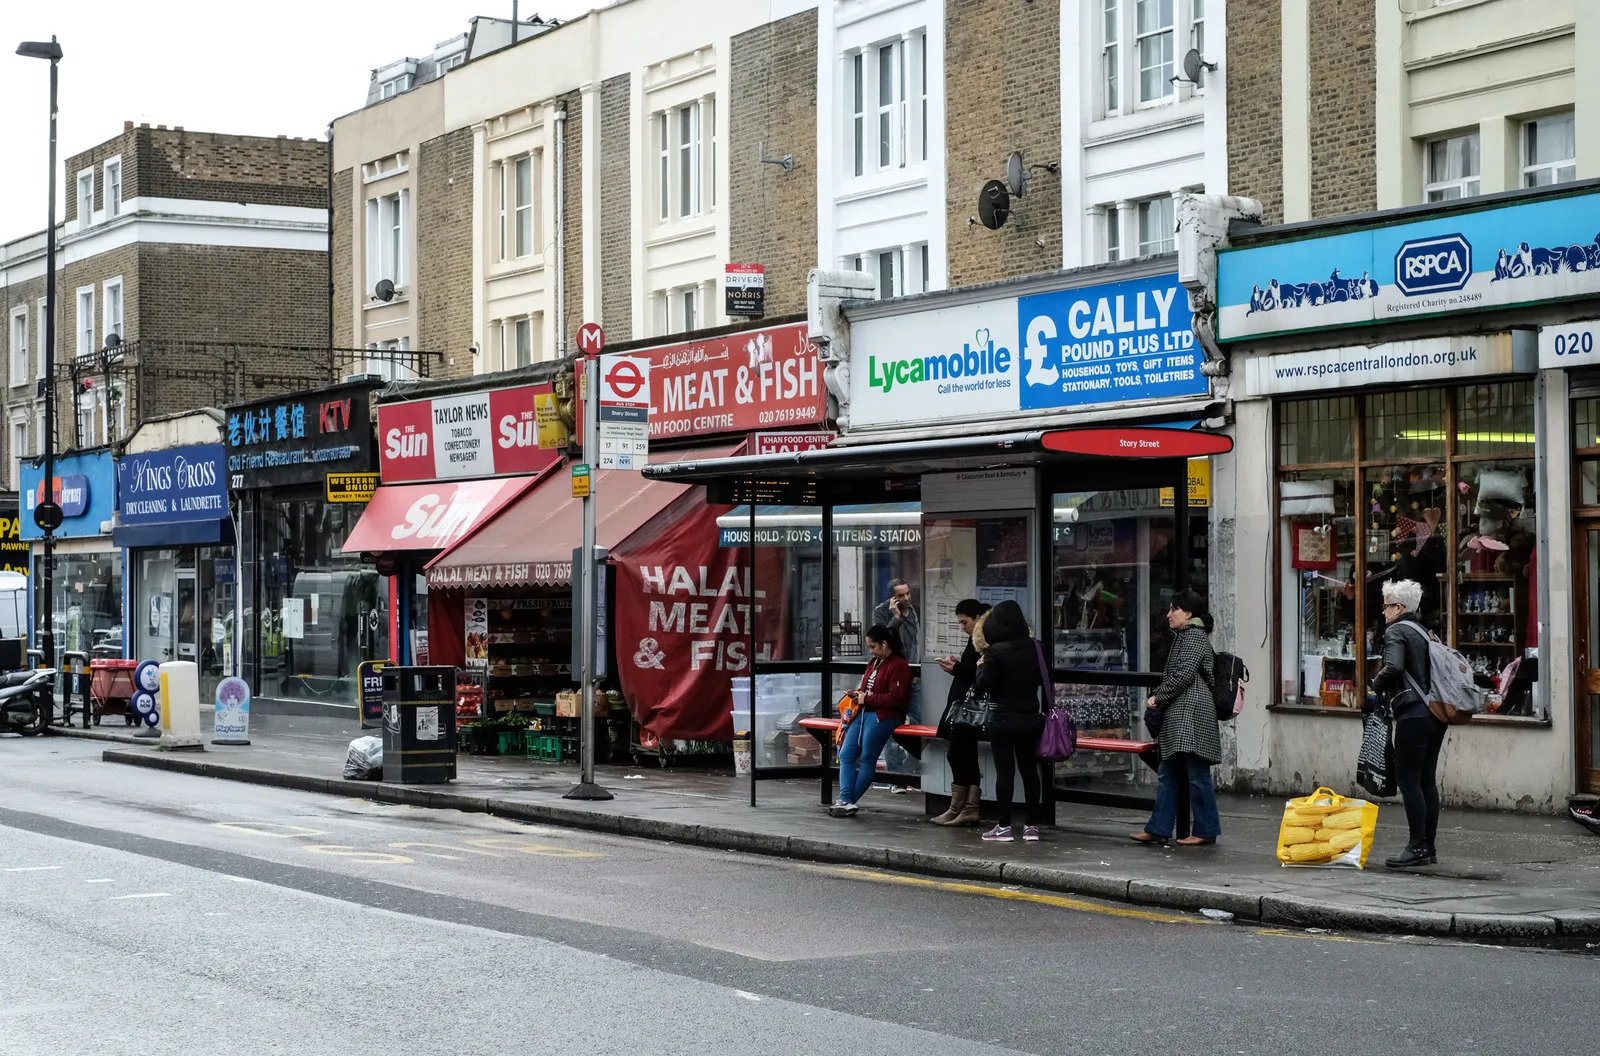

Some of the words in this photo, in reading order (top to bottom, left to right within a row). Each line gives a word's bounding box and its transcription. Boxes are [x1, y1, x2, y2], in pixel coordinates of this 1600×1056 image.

[1405, 249, 1462, 278] RSPCA
[728, 291, 761, 299] NORRIS
[1387, 300, 1420, 312] Registered
[1422, 298, 1447, 309] Charity
[1459, 292, 1482, 303] 248489
[1068, 287, 1177, 339] CALLY
[582, 328, 601, 349] M
[1061, 341, 1114, 363] POUND
[1123, 334, 1159, 356] PLUS
[1164, 330, 1194, 351] LTD
[1554, 331, 1593, 356] 020
[868, 340, 1011, 393] Lycamobile
[1062, 364, 1112, 379] HOUSEHOLD,
[1116, 361, 1139, 373] TOYS,
[1143, 358, 1162, 370] GIFT
[1167, 355, 1194, 367] ITEMS
[1275, 347, 1478, 380] www.rspcacentrallondon.org.uk
[663, 368, 729, 414] MEAT
[735, 365, 754, 404] &
[760, 355, 818, 401] FISH
[937, 384, 951, 394] Call
[952, 383, 964, 393] the
[964, 380, 984, 391] world
[985, 380, 995, 389] for
[996, 378, 1011, 388] less
[1062, 378, 1112, 392] STATIONARY,
[1114, 375, 1142, 387] TOOLS,
[1144, 369, 1194, 384] TOILETRIES
[319, 398, 351, 433] KTV
[434, 406, 463, 425] TAYLOR
[465, 403, 488, 421] NEWS
[521, 411, 532, 420] THE
[663, 419, 691, 433] FOOD
[694, 413, 733, 431] CENTRE
[759, 411, 774, 424] 020
[775, 409, 795, 422] 7619
[795, 407, 816, 420] 9449
[228, 403, 305, 446] 老伙计餐馆
[405, 425, 415, 433] THE
[451, 427, 472, 438] TOBACCO
[385, 428, 428, 460] Sun
[444, 438, 481, 451] CONFECTIONERY
[763, 436, 783, 444] KHAN
[784, 435, 803, 443] FOOD
[804, 435, 829, 443] CENTRE
[1119, 438, 1138, 449] Story
[1139, 438, 1159, 449] Street
[449, 451, 477, 463] NEWSAGENT
[130, 459, 171, 493] KINGS
[174, 455, 216, 490] CROSS
[231, 474, 244, 488] 277
[330, 477, 375, 485] WESTERN
[171, 499, 177, 511] &
[180, 495, 222, 511] LAUNDRETTE
[723, 530, 779, 542] HOUSHOLD
[786, 530, 811, 542] TOYS
[842, 529, 873, 542] ITEMS
[430, 567, 463, 583] HALAL
[464, 566, 493, 582] MEAT
[495, 566, 503, 579] &
[505, 563, 529, 579] FISH
[535, 564, 550, 579] 020
[640, 565, 766, 598] HALAL
[649, 600, 763, 635] MEAT
[633, 637, 666, 670] &
